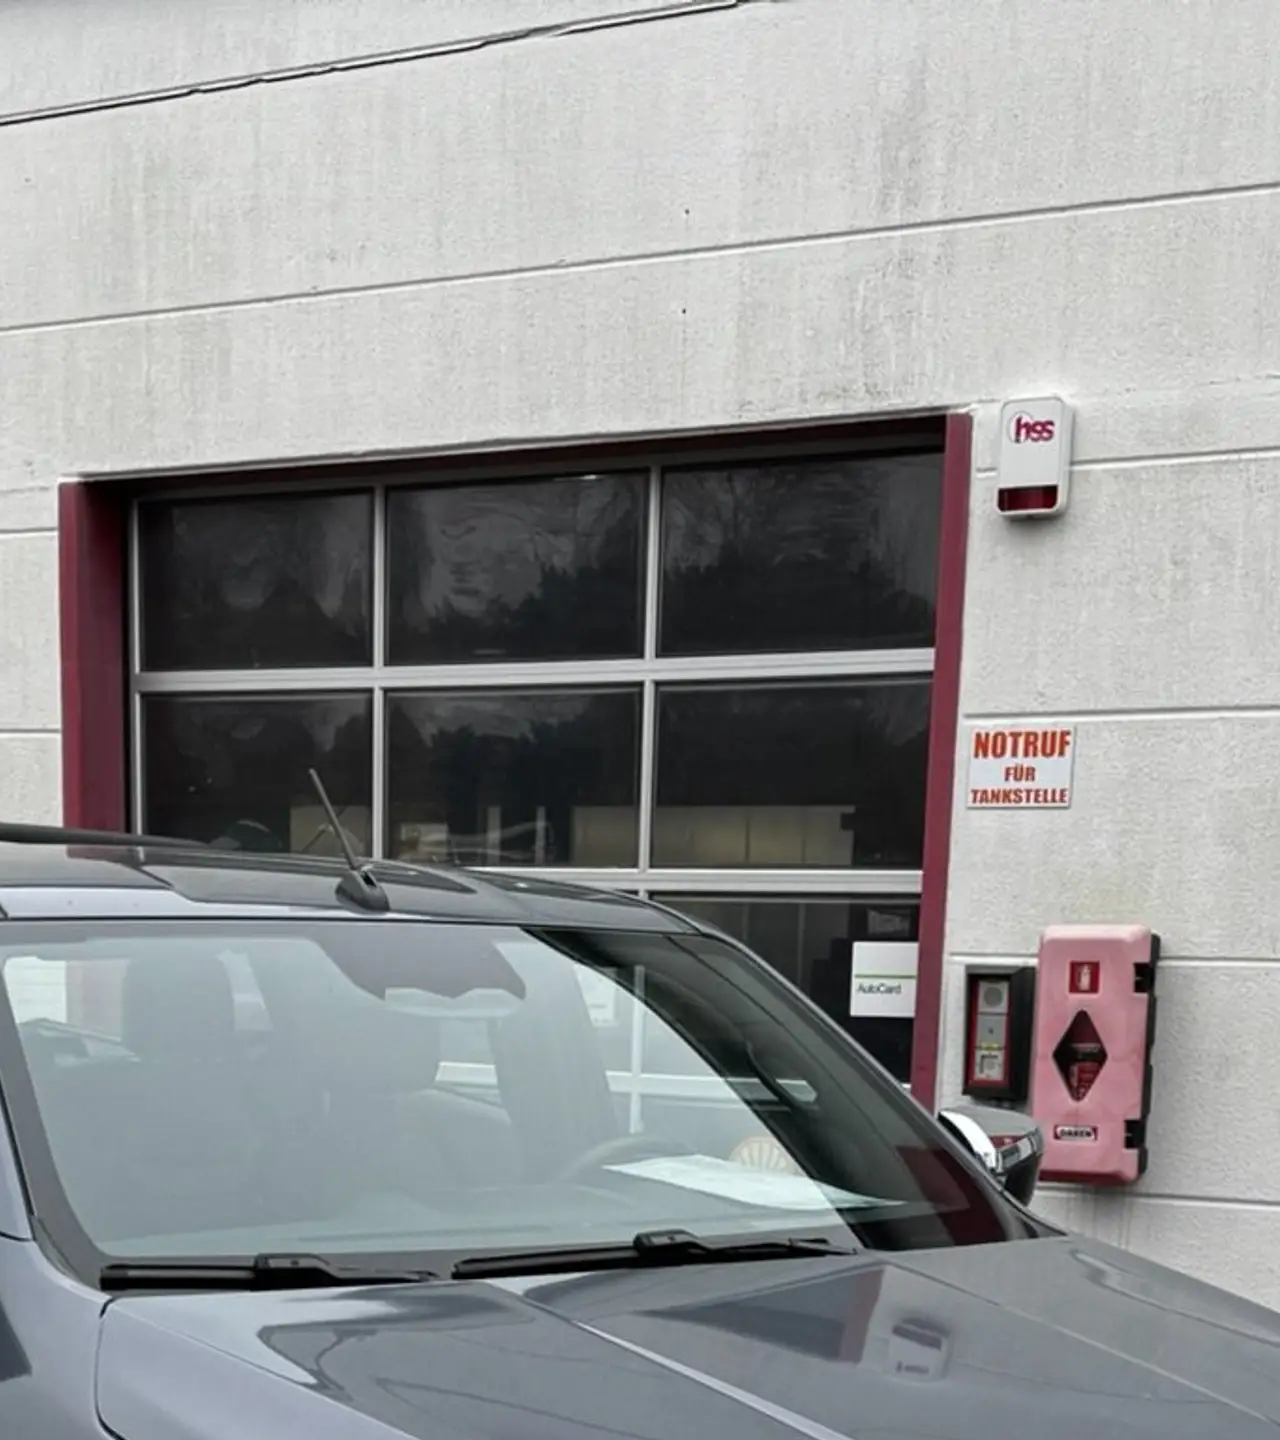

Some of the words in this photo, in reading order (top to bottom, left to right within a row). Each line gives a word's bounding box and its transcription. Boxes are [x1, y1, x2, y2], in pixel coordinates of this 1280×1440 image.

[1014, 415, 1055, 444] hss
[973, 729, 1072, 759] NOTRUF
[1003, 763, 1036, 782] FÜR
[970, 787, 1069, 804] TANKSTELLE
